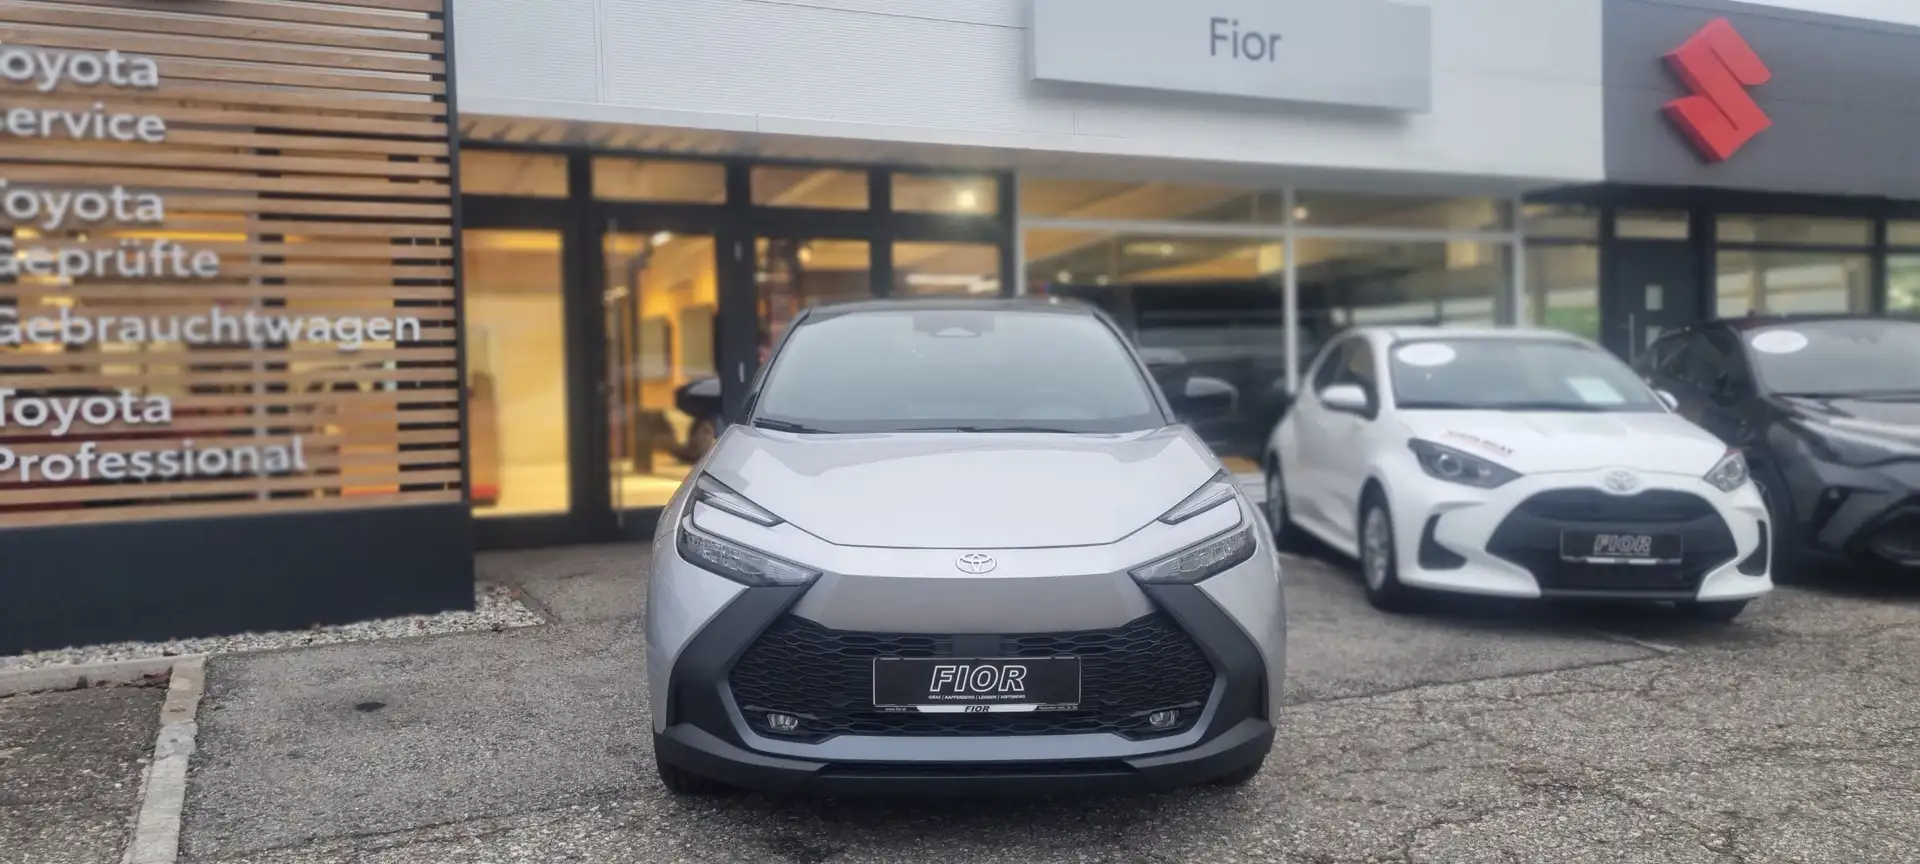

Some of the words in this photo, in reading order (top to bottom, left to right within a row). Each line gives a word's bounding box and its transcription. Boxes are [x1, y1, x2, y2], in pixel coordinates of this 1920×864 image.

[1210, 17, 1281, 62] Fior
[0, 43, 160, 91] oyota
[0, 102, 167, 142] ervice
[0, 178, 164, 229] oyota
[1593, 534, 1651, 552] FIOR
[929, 665, 1027, 692] FIOR
